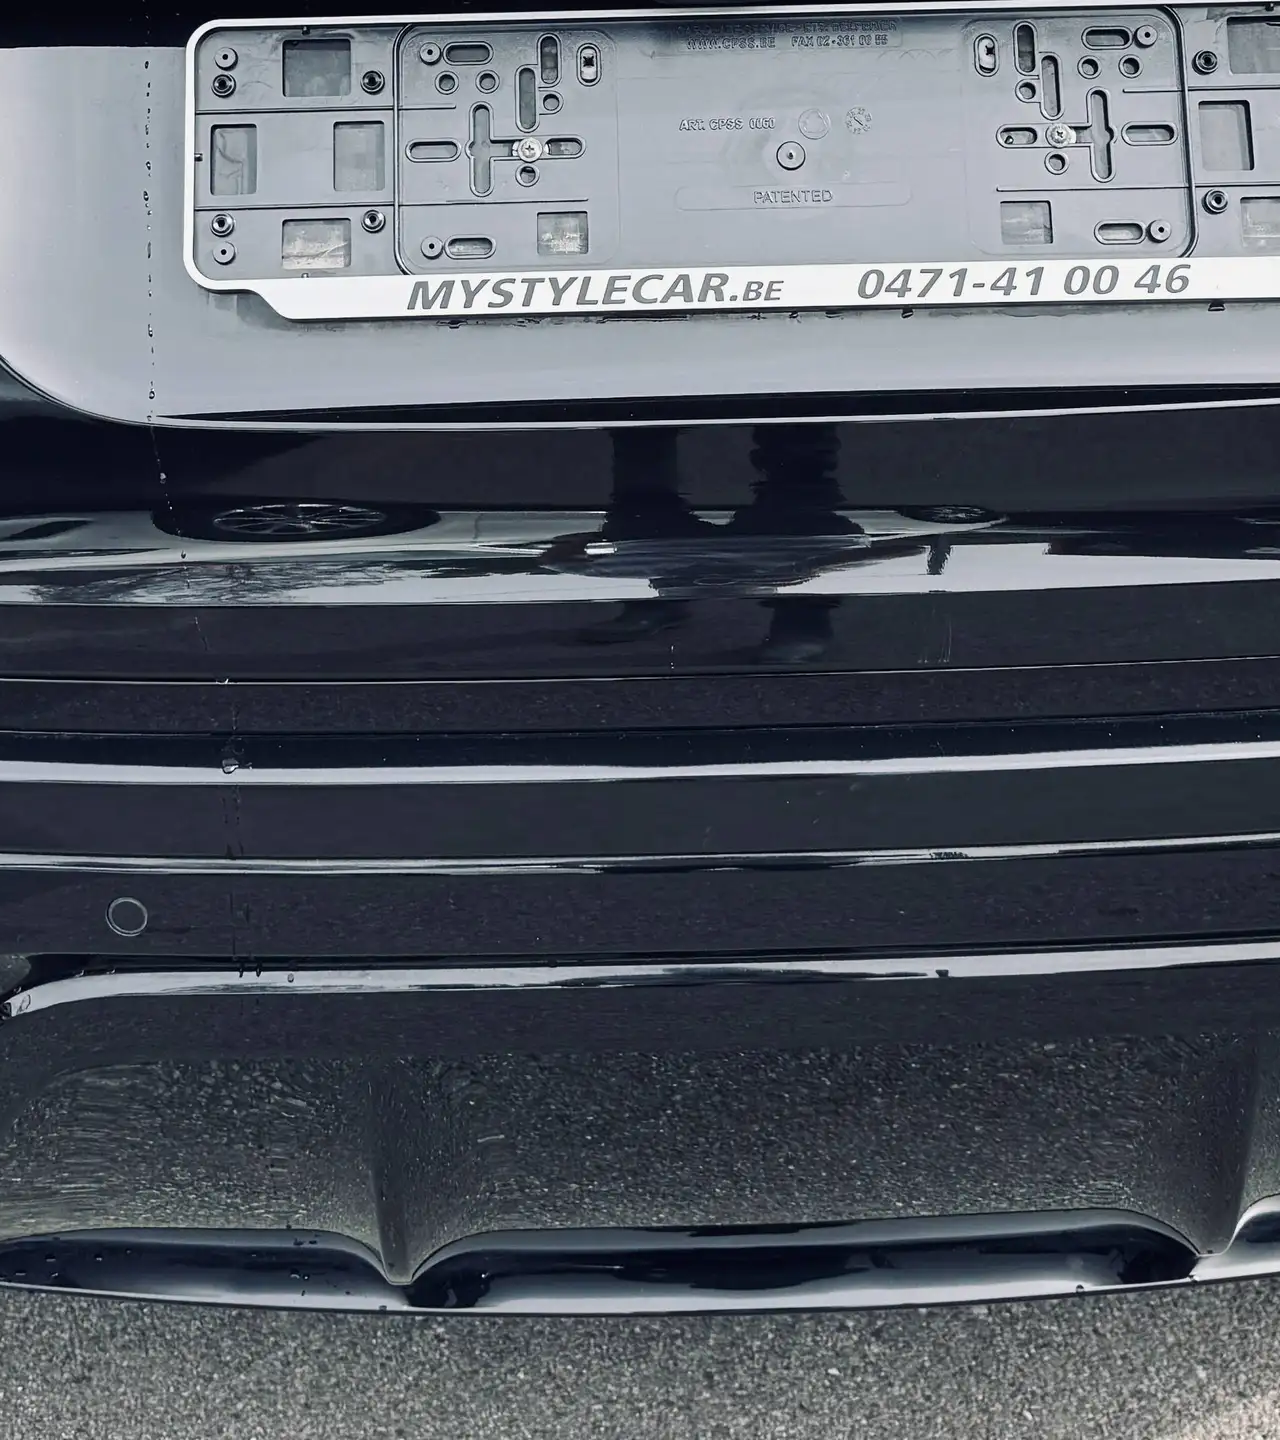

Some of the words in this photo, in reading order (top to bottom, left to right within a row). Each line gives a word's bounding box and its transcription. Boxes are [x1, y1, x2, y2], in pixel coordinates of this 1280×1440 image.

[753, 189, 834, 204] PATENTED
[407, 272, 784, 311] MYSTYLECAR.BE
[857, 266, 1046, 300] 0471-41
[1063, 264, 1120, 296] 00
[1134, 263, 1192, 295] 46
